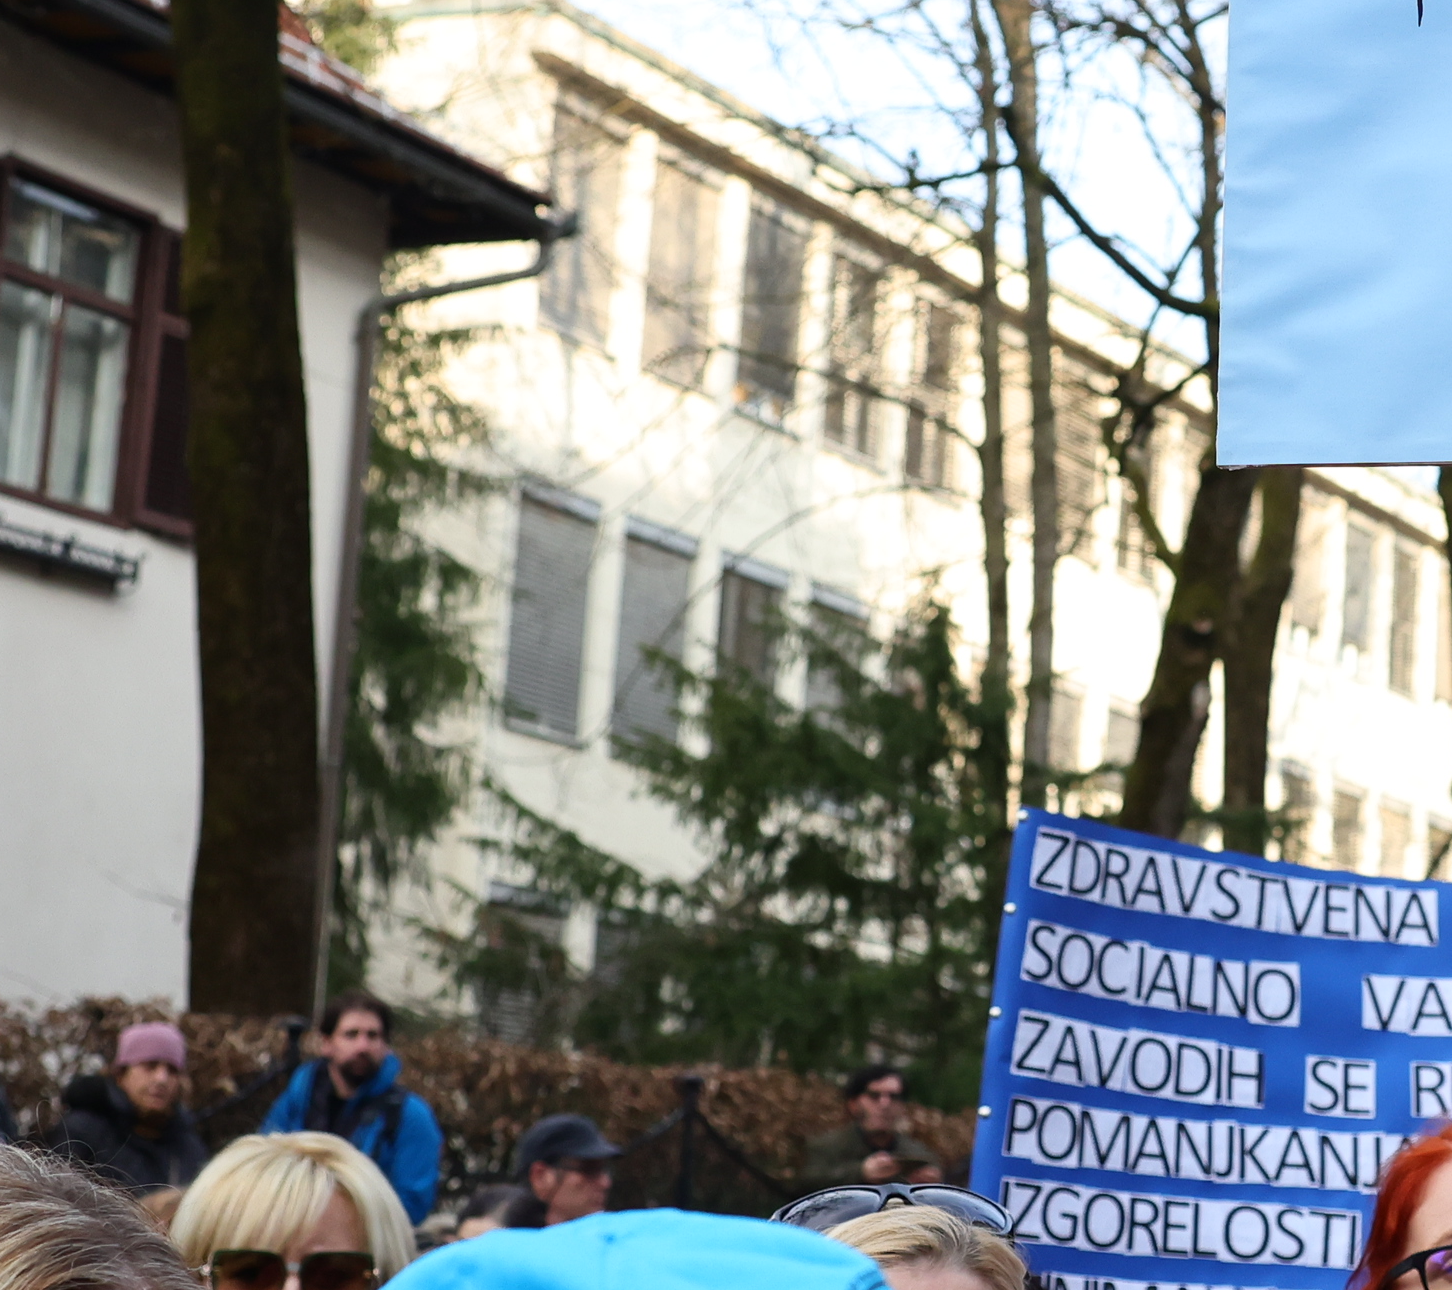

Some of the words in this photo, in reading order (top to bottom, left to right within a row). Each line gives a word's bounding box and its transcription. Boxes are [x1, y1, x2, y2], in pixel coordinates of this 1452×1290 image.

[1036, 831, 1436, 946] ZDRAVSTVENA
[1023, 923, 1298, 1024] SOCIALNO
[1012, 1014, 1264, 1106] ZAVODIH
[1309, 1059, 1376, 1116] SE
[1007, 1100, 1411, 1188] POMANJKANJ
[1002, 1180, 1360, 1266] IZGORELOSTI
